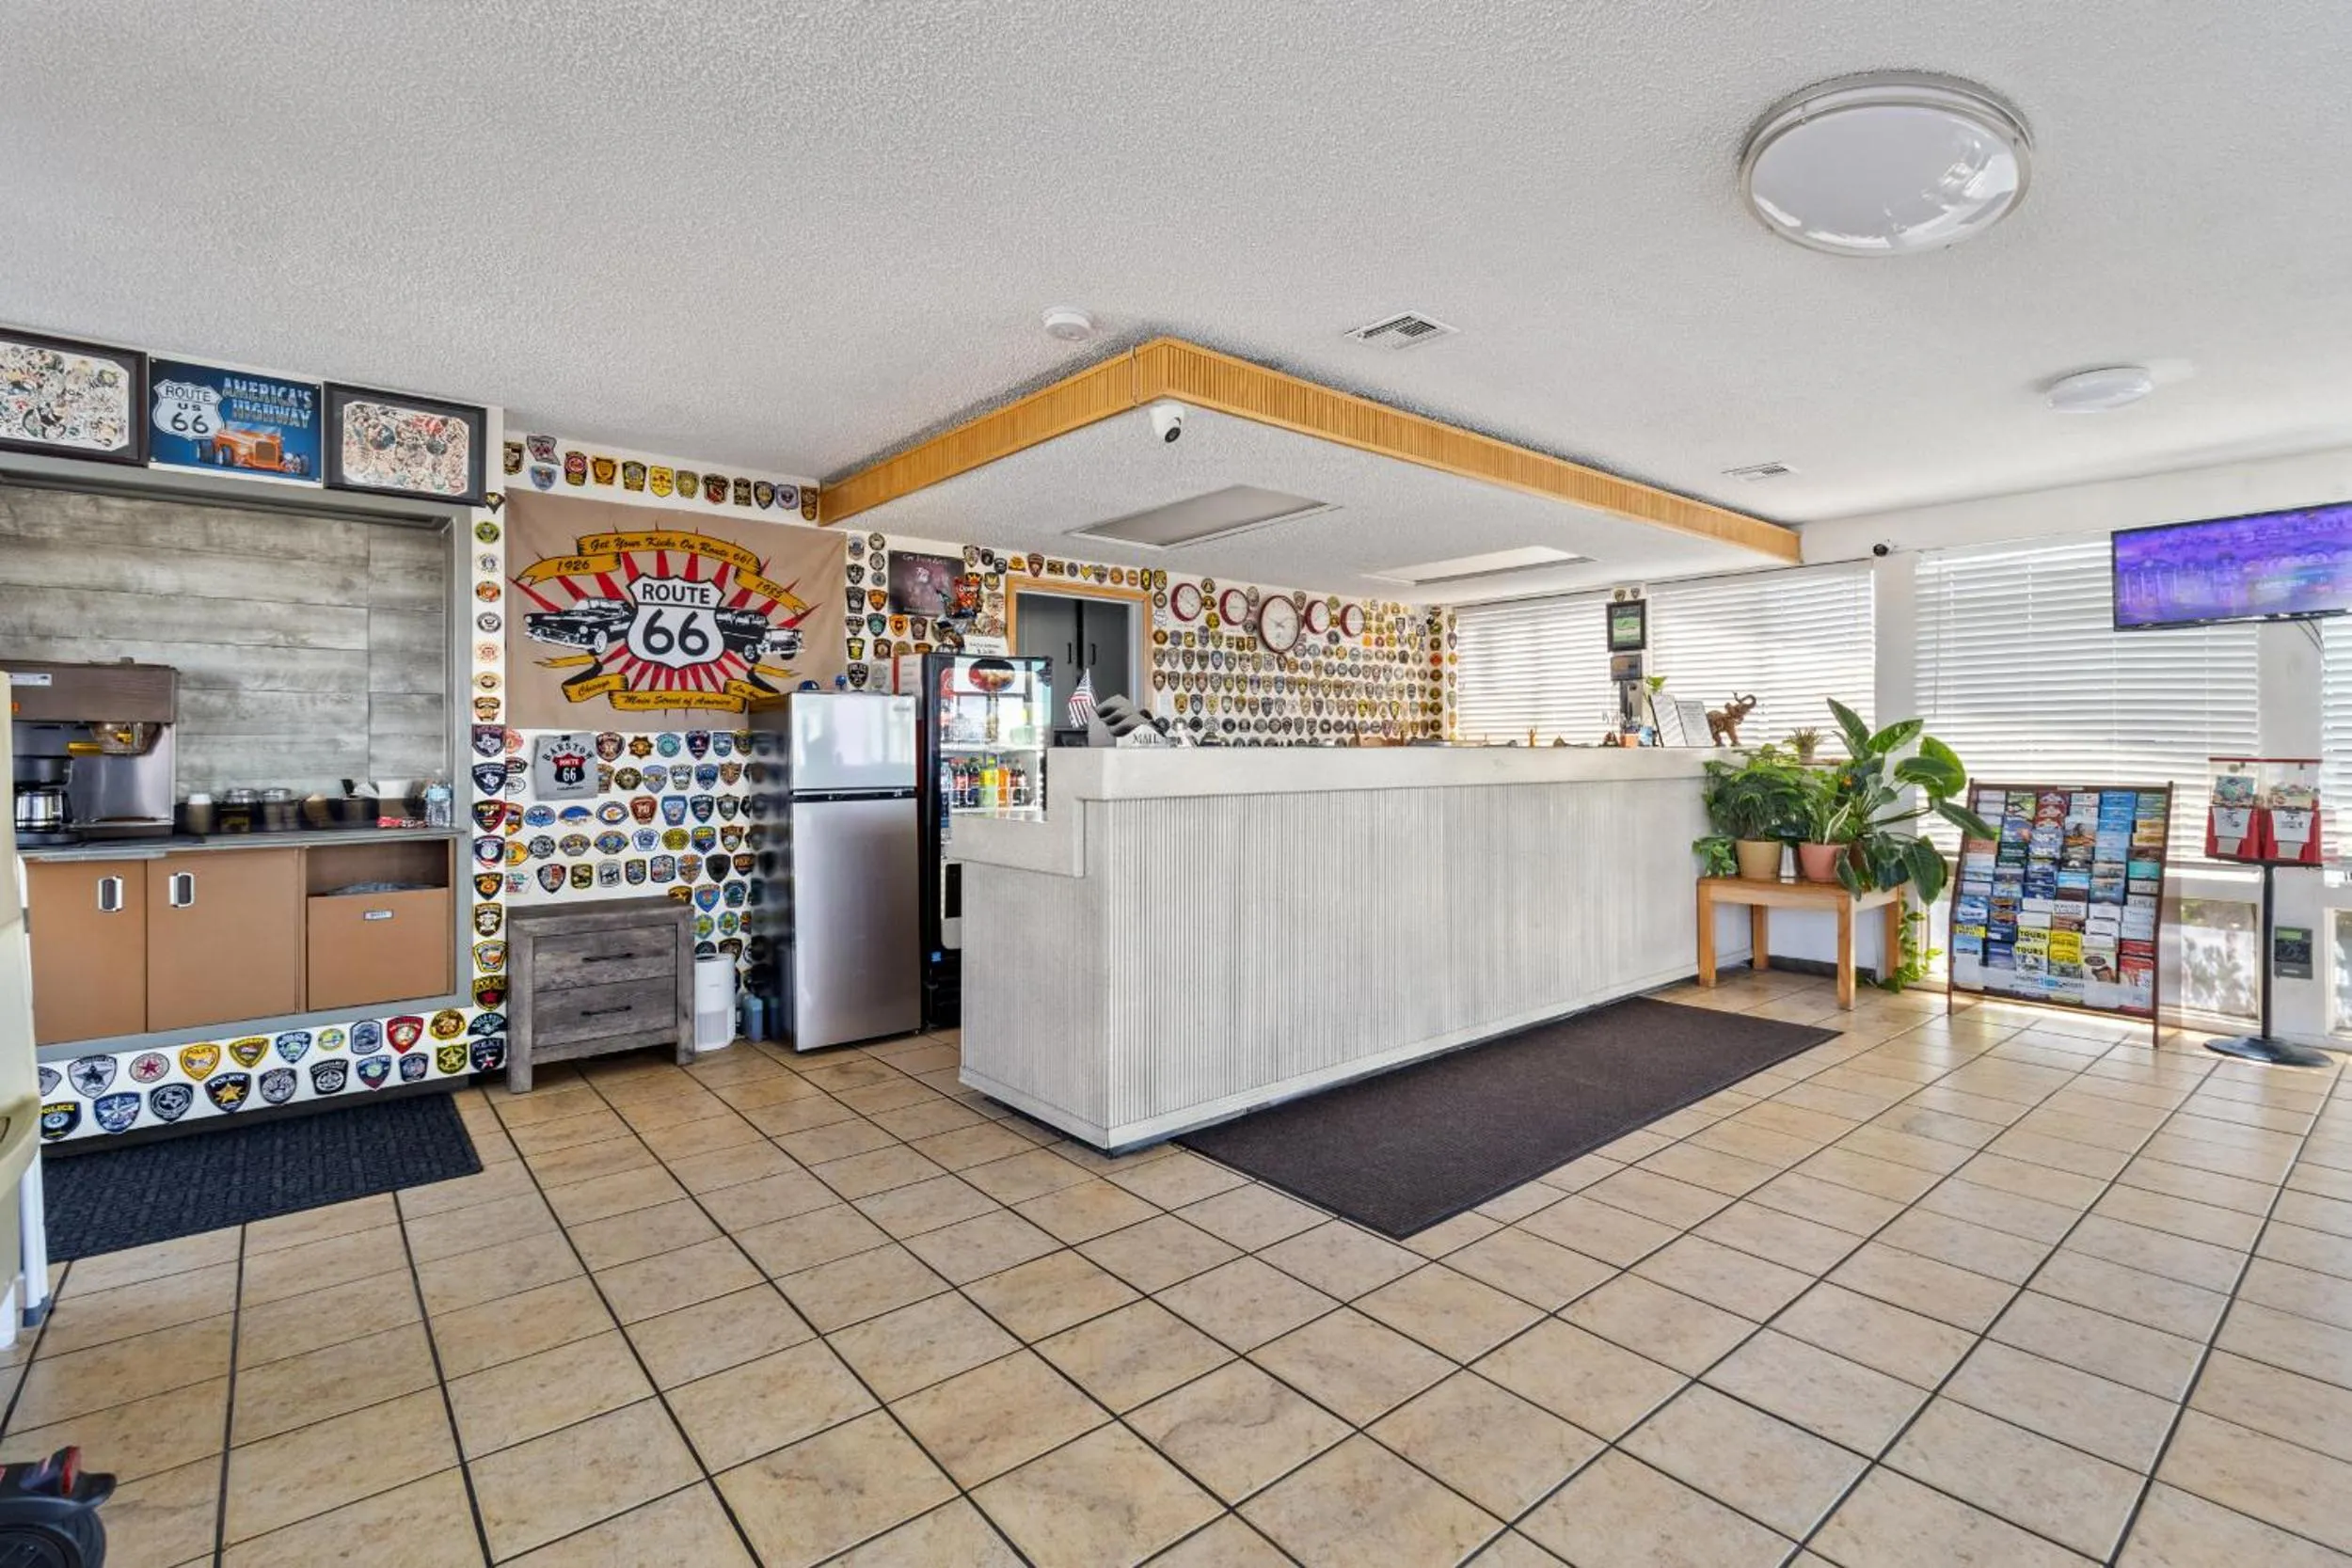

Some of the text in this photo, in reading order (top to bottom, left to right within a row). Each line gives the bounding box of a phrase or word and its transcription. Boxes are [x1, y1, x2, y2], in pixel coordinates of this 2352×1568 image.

[166, 385, 212, 403] ROUTE
[222, 377, 313, 409] AMERICA'S
[177, 402, 202, 412] US
[231, 399, 312, 430] HIGHWAY
[170, 412, 209, 435] 66
[590, 539, 609, 552] Get
[614, 537, 641, 552] Your
[645, 536, 676, 547] Kicks
[679, 539, 695, 550] On
[699, 542, 729, 558] Route
[556, 560, 591, 572] 1926
[642, 582, 711, 604] ROUTE
[643, 609, 709, 657] 66
[1133, 734, 1159, 744] MAIL
[542, 742, 595, 761] BARSTOW
[563, 767, 577, 782] 66
[2020, 930, 2047, 940] TOURS
[2016, 946, 2043, 956] TOURS
[210, 1074, 246, 1088] POLICE
